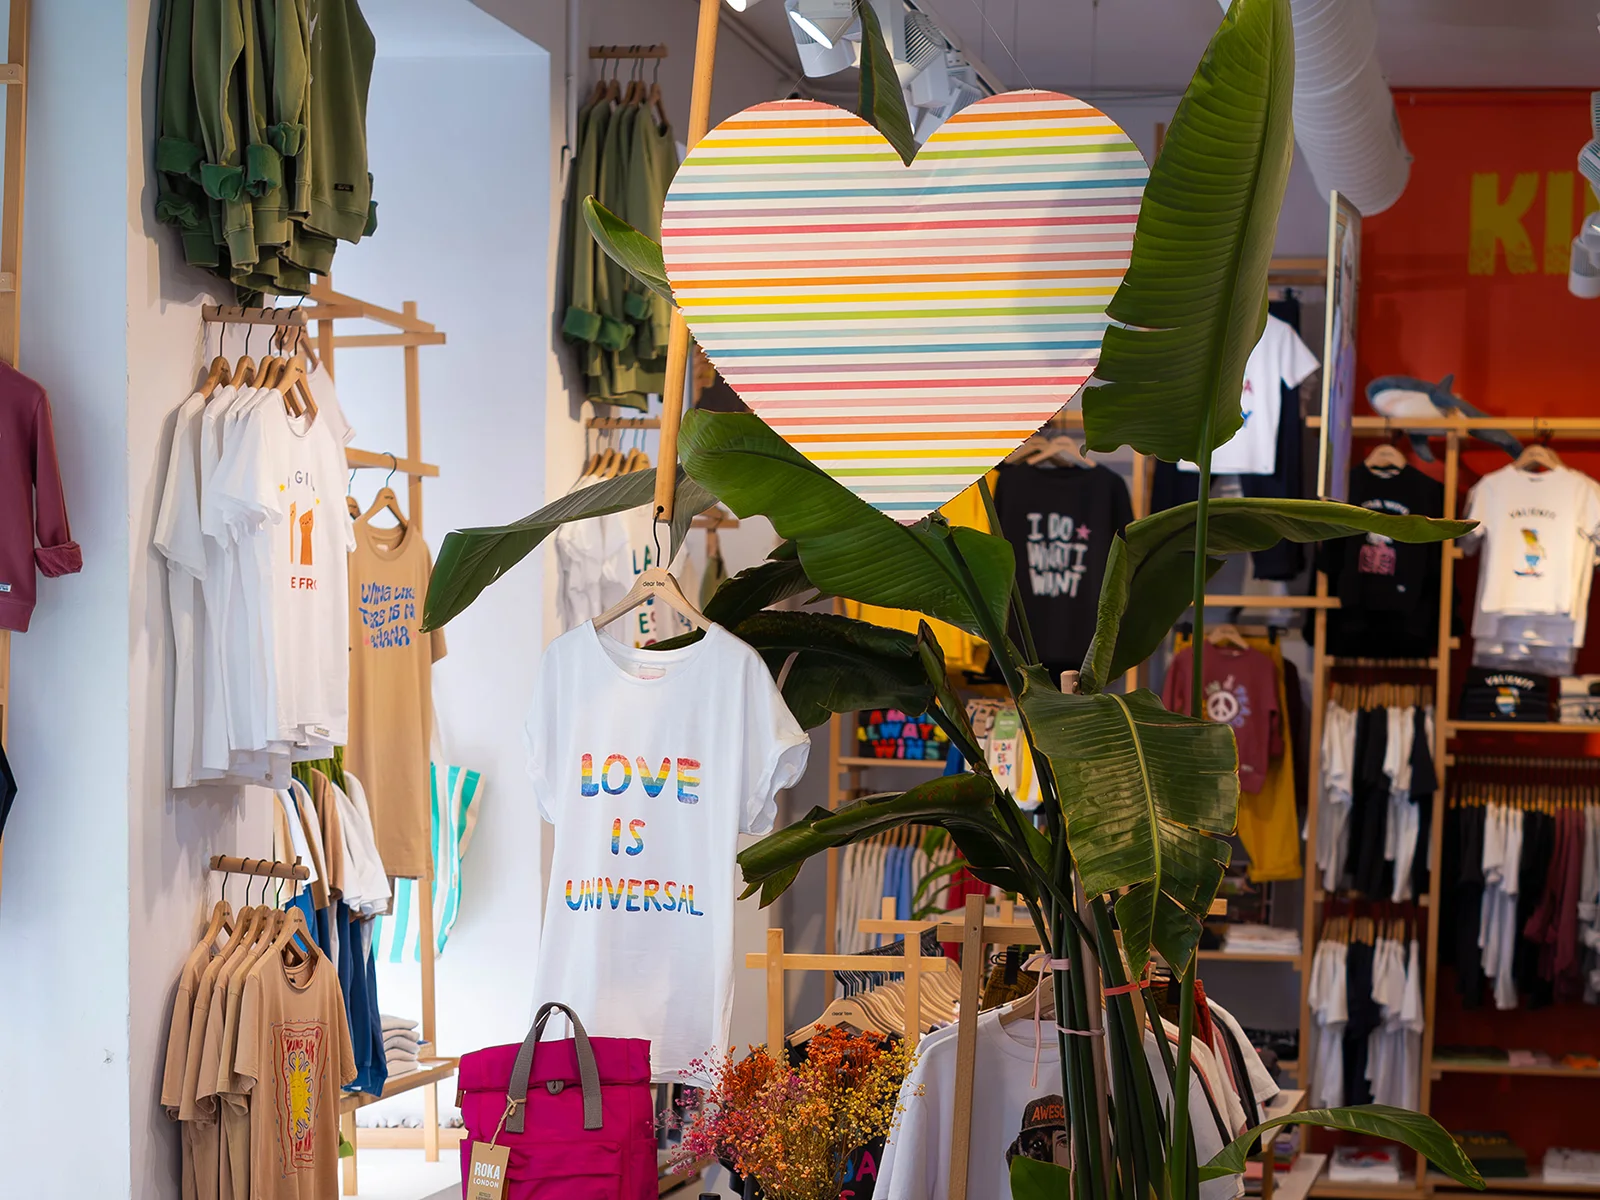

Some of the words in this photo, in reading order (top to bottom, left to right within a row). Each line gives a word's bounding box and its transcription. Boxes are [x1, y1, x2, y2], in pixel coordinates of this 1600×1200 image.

[1468, 171, 1600, 275] KI
[1026, 512, 1044, 541] I
[1047, 512, 1074, 541] DO
[1026, 541, 1072, 571] WHAT
[1071, 543, 1088, 573] I
[394, 586, 415, 600] LIK
[1028, 567, 1081, 598] WANT
[857, 722, 947, 742] ALWAYS
[581, 753, 701, 804] LOVE
[611, 818, 645, 856] IS
[565, 877, 703, 916] UNIVERSAL
[1032, 1104, 1065, 1121] AWESO
[473, 1178, 499, 1188] LONDON
[474, 1161, 500, 1179] ROKA
